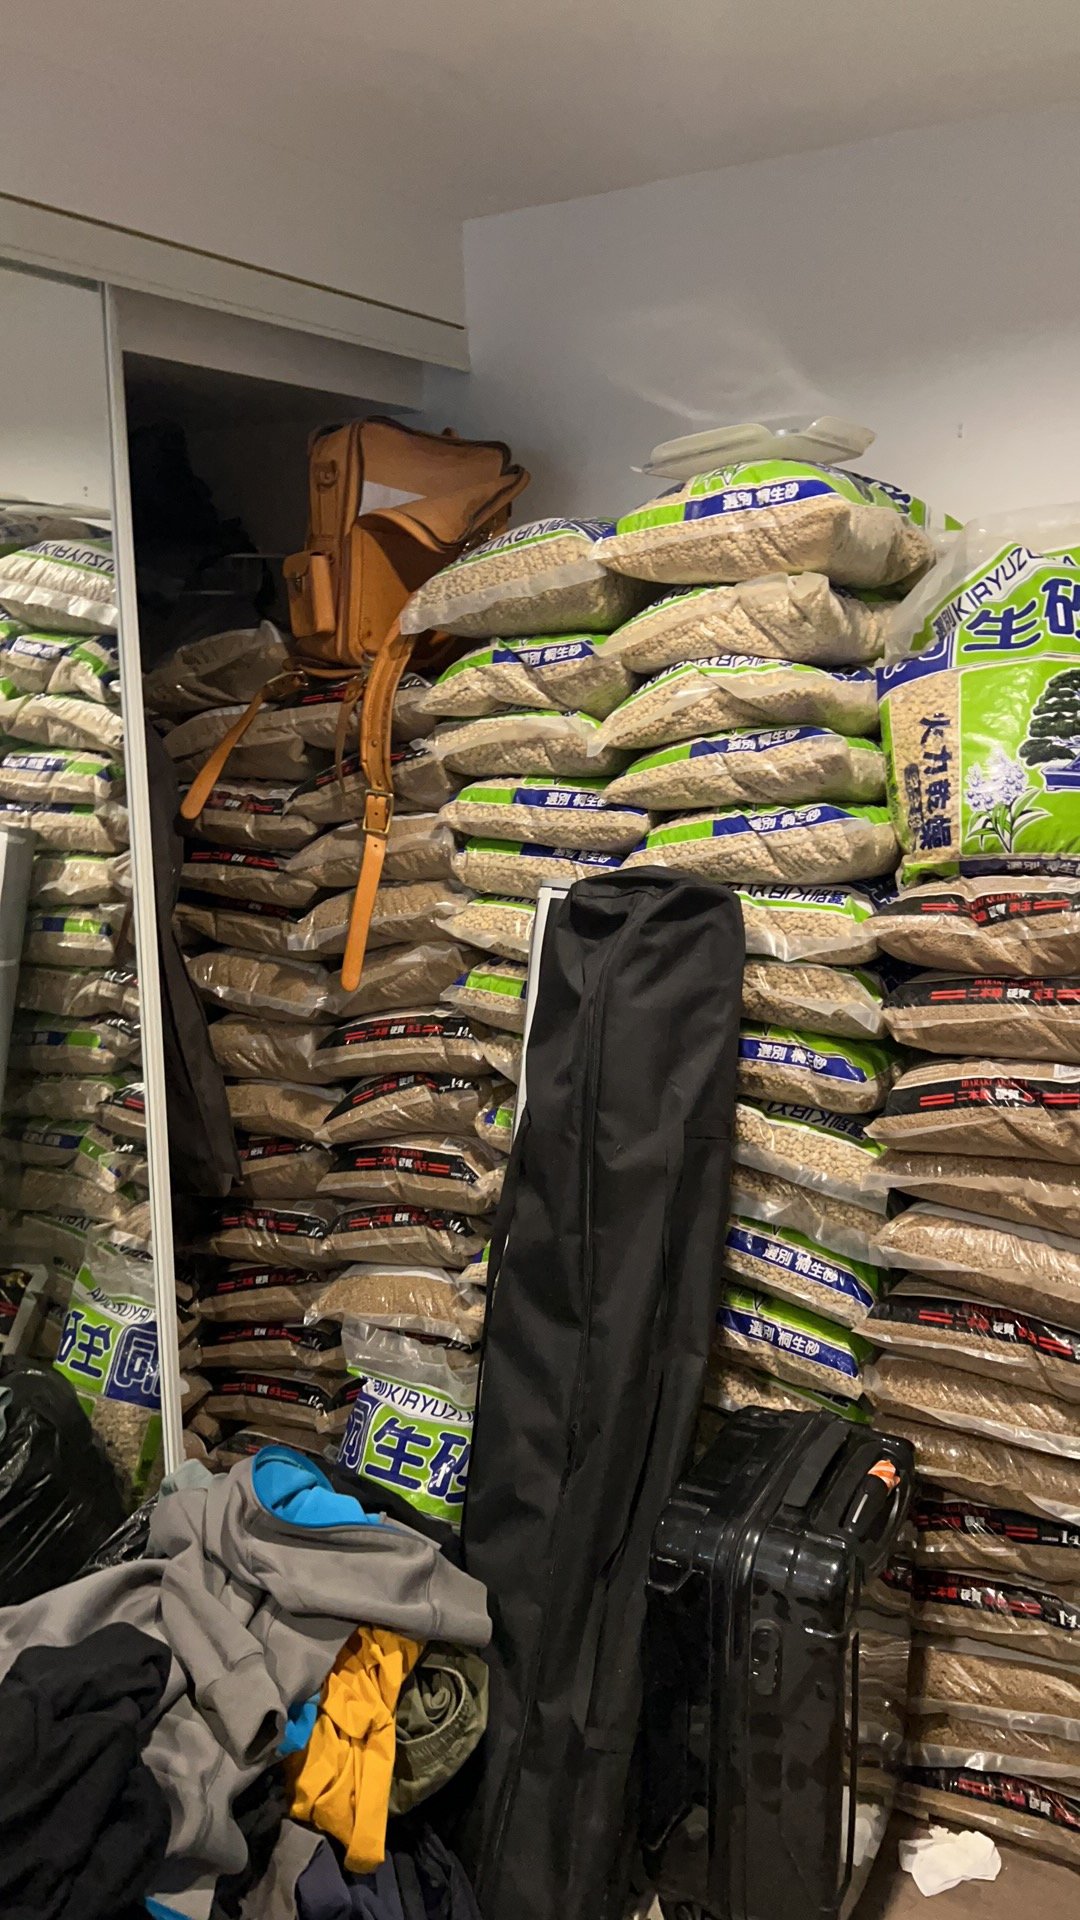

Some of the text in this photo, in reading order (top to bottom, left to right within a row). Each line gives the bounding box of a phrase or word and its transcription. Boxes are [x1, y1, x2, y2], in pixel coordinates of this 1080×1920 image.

[544, 791, 571, 805] 選別
[756, 1042, 787, 1061] 選別
[762, 1243, 838, 1283] 選別 桐生砂
[748, 1319, 820, 1357] 選別 桐生砂
